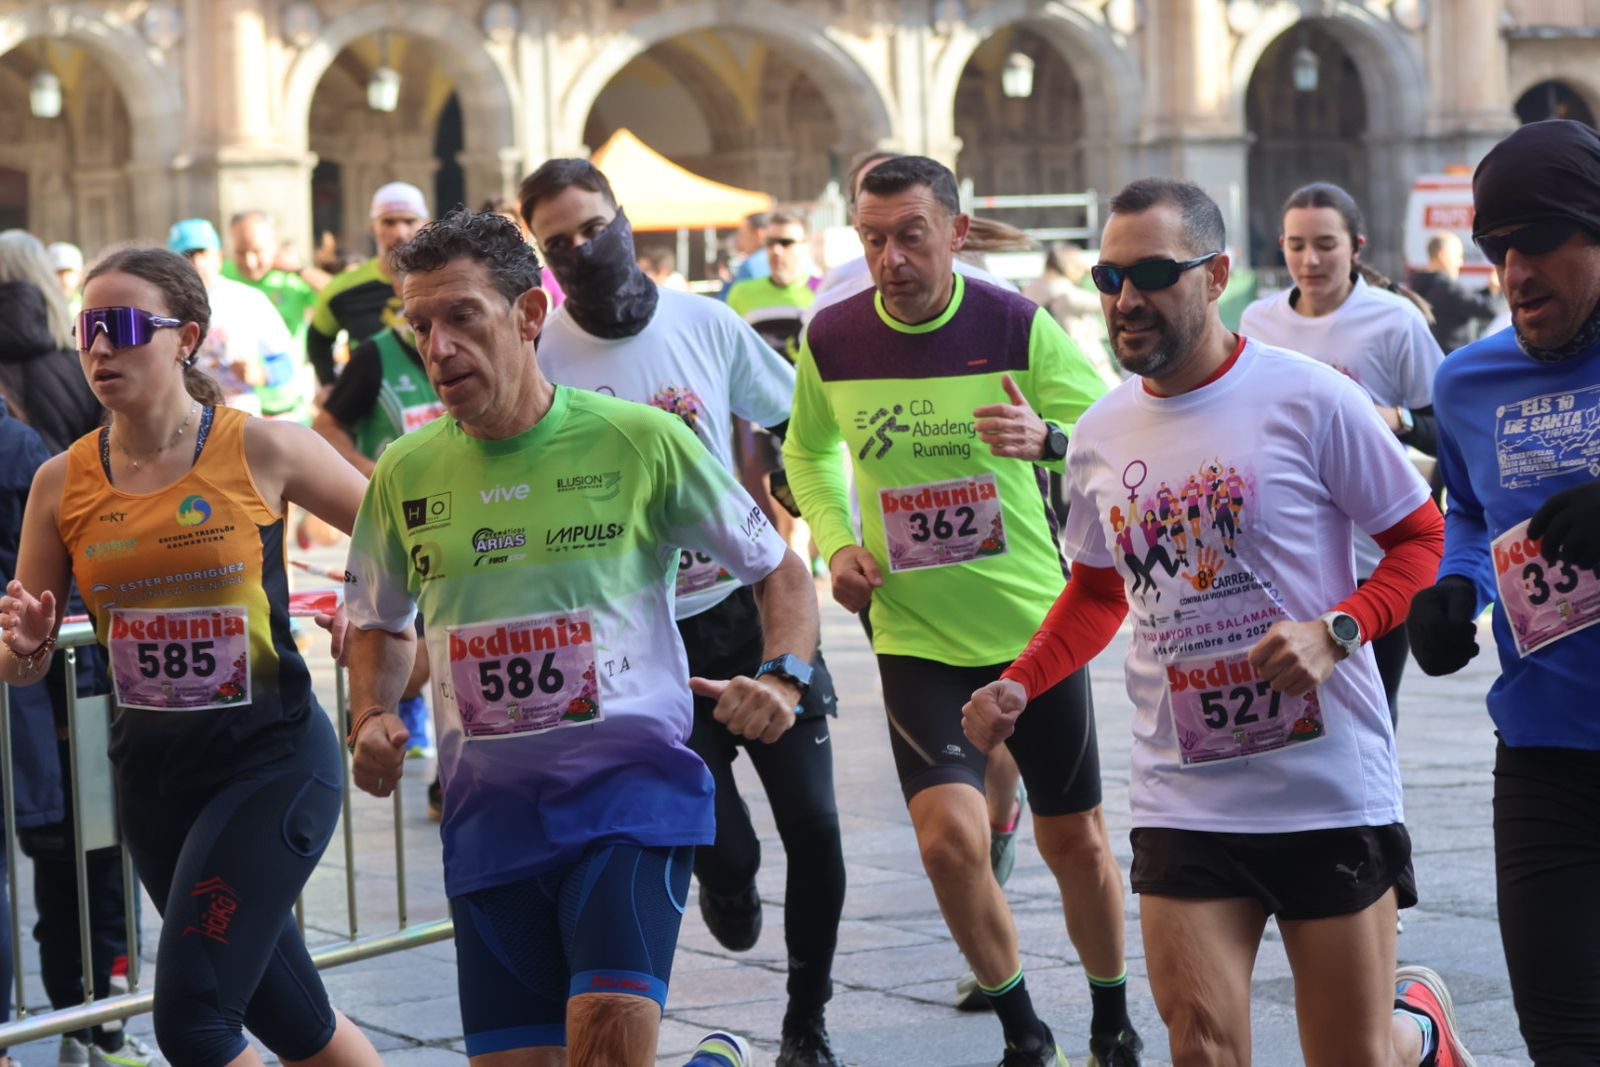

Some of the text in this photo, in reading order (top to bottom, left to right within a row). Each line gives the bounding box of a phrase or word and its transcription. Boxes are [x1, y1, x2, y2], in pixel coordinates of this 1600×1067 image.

[909, 399, 935, 416] C.D.
[1521, 397, 1552, 416] ELS
[912, 419, 977, 439] Abadeng
[1504, 410, 1582, 435] DE SANTA
[913, 442, 971, 459] Running
[480, 482, 531, 505] vive
[880, 480, 997, 513] bedunia
[909, 506, 978, 542] 362
[159, 532, 194, 544] ESCUELA
[476, 534, 526, 552] ARIAS
[120, 562, 246, 592] ESTER RODRIGUEZ
[1180, 594, 1203, 606] CONTRA
[1210, 587, 1241, 600] VIOLENCIA
[1243, 585, 1250, 593] DE
[112, 612, 244, 640] bedunia
[1159, 627, 1193, 641] MAYOR
[1196, 622, 1213, 635] DE
[1227, 632, 1242, 643] de
[449, 617, 593, 662] bedunia
[137, 641, 216, 679] 585
[478, 651, 565, 702] 586
[1166, 660, 1261, 692] bedu
[1200, 680, 1282, 730] 527
